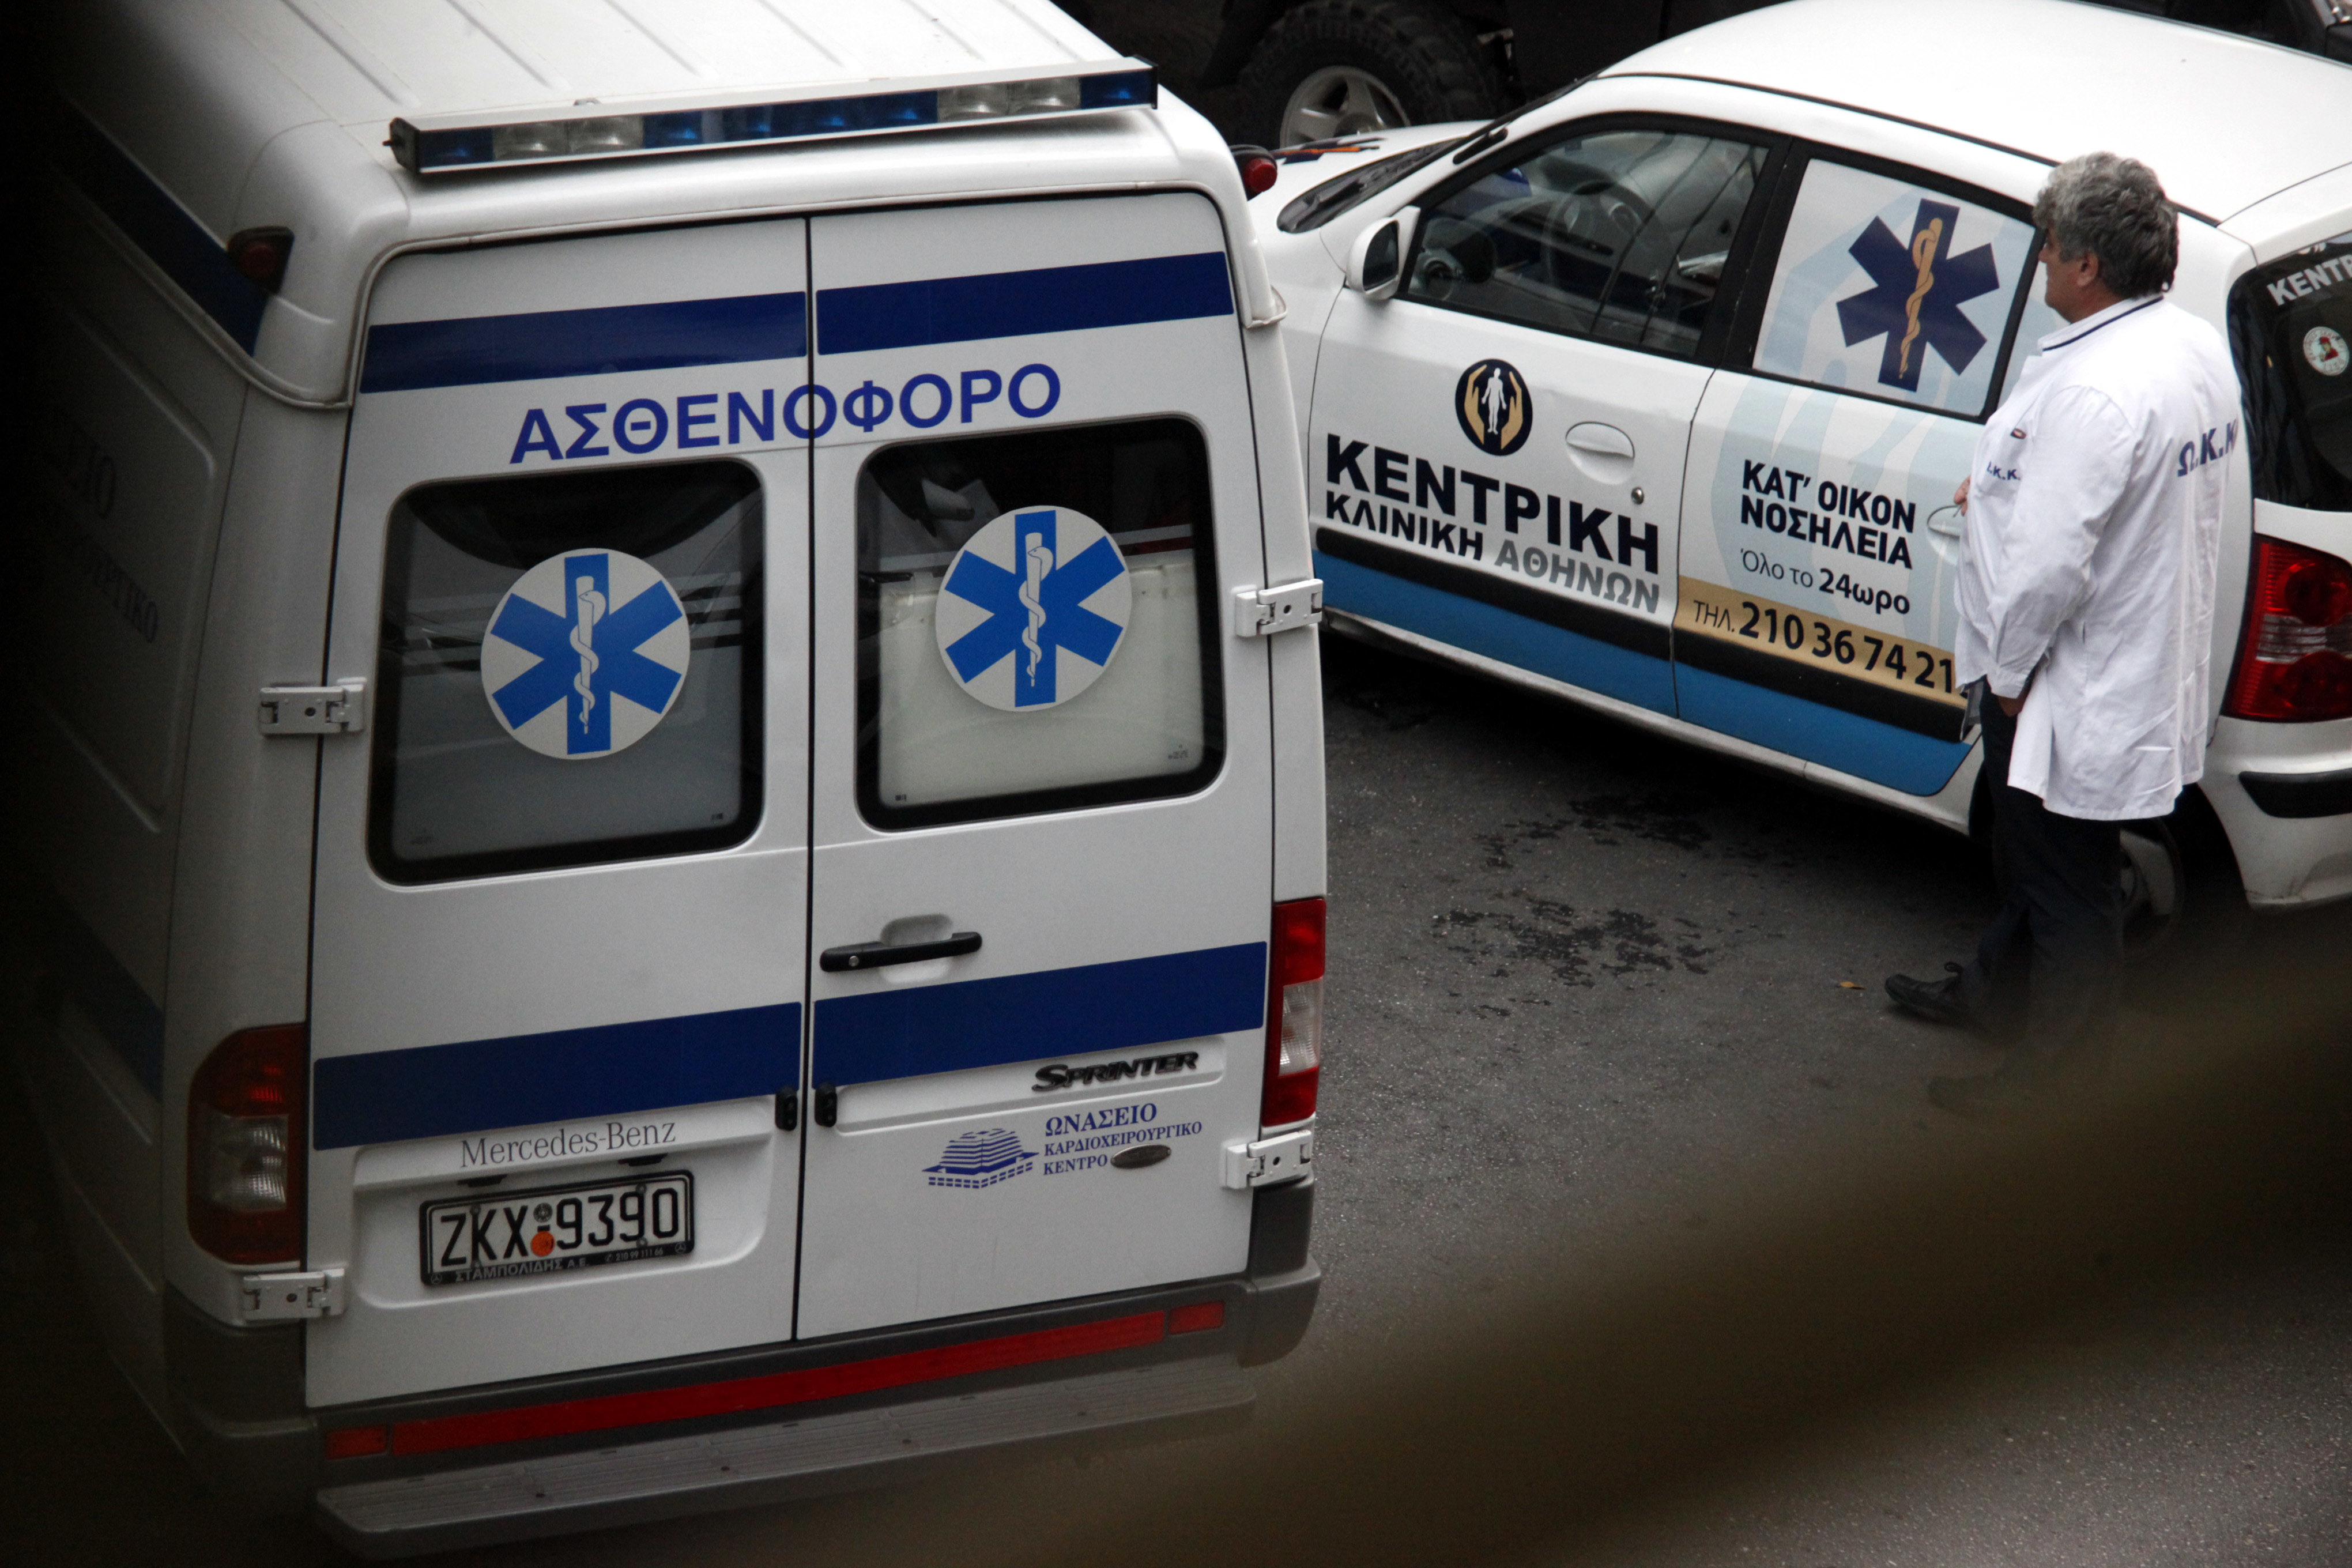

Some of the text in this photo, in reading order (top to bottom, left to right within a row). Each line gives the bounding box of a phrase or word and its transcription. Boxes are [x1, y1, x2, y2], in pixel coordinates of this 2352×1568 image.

[509, 363, 1061, 463] ΑΣΘΕΝΟΦΟΡΟ
[1326, 433, 1659, 575] ΚΕΝΤΡΙΚΗ
[1818, 480, 1916, 534] ΟΙΚΟΝ
[1326, 490, 1659, 614] ΚΛΙΝΙΚΗ ΑΘΗΝΩΝ
[1740, 494, 1913, 570] ΝΟΣΗΛΕΙΑ
[1789, 567, 1814, 588] το
[1819, 568, 1910, 615] 24ωρο
[1693, 600, 1736, 633] ΤΗΛ.
[1739, 601, 1804, 650] 210
[1032, 1051, 1199, 1092] SPRINTER
[1043, 1121, 1203, 1156] ΚΑΡΔΙΟΧΕΙΡΟΥΡΓΙΚΟ
[1045, 1103, 1158, 1137] ΩΝΑΣΕΙΟ
[461, 1122, 676, 1168] Mercedes-Benz
[1043, 1154, 1108, 1175] ΚΕΝΤΡΟ
[455, 1258, 563, 1283] ΣΤΑΜΠΟΛΙΔΗΣ
